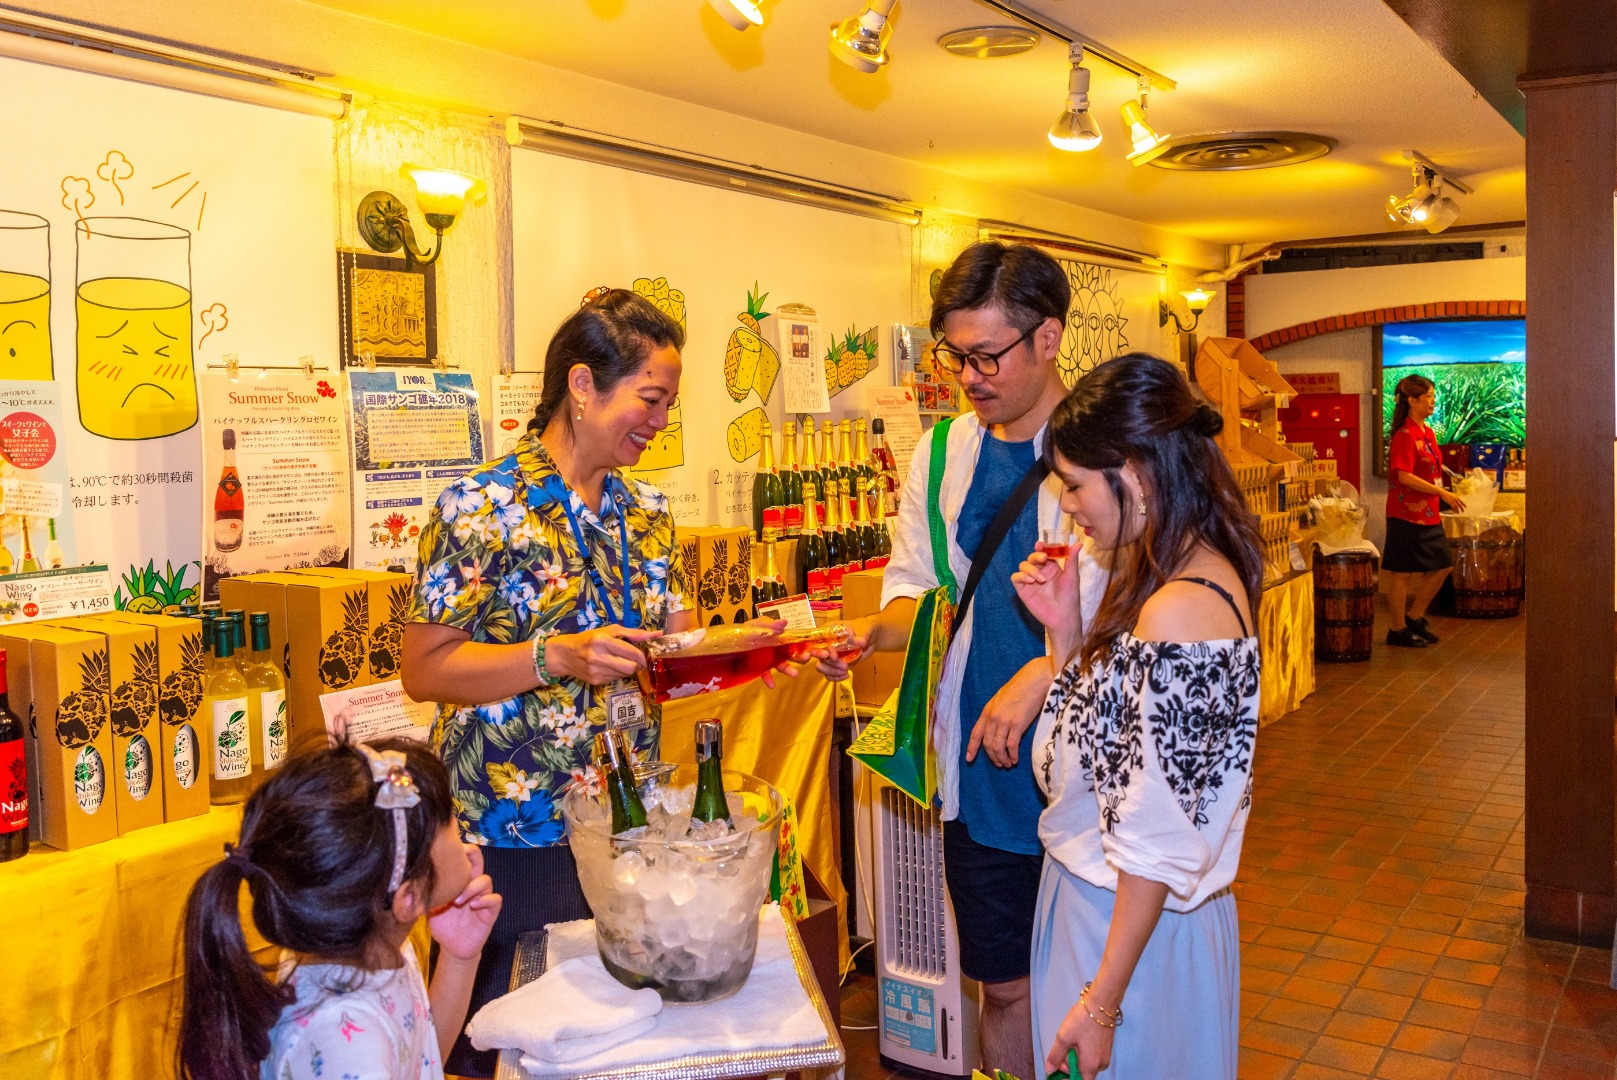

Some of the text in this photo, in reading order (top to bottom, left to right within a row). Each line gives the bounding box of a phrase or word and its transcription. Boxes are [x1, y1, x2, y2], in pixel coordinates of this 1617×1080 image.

[229, 391, 319, 404] Summer Snow
[365, 394, 466, 405] 国際サンゴ礁年2018
[12, 428, 39, 438] 女子会
[676, 508, 700, 519] ジュース
[5, 583, 33, 592] Nago
[7, 591, 32, 599] Wine
[349, 690, 407, 707] Summer Snow
[618, 704, 636, 719] 国吉
[220, 748, 248, 759] Nago
[220, 763, 246, 772] Wine
[885, 980, 929, 998] マイナスイオン
